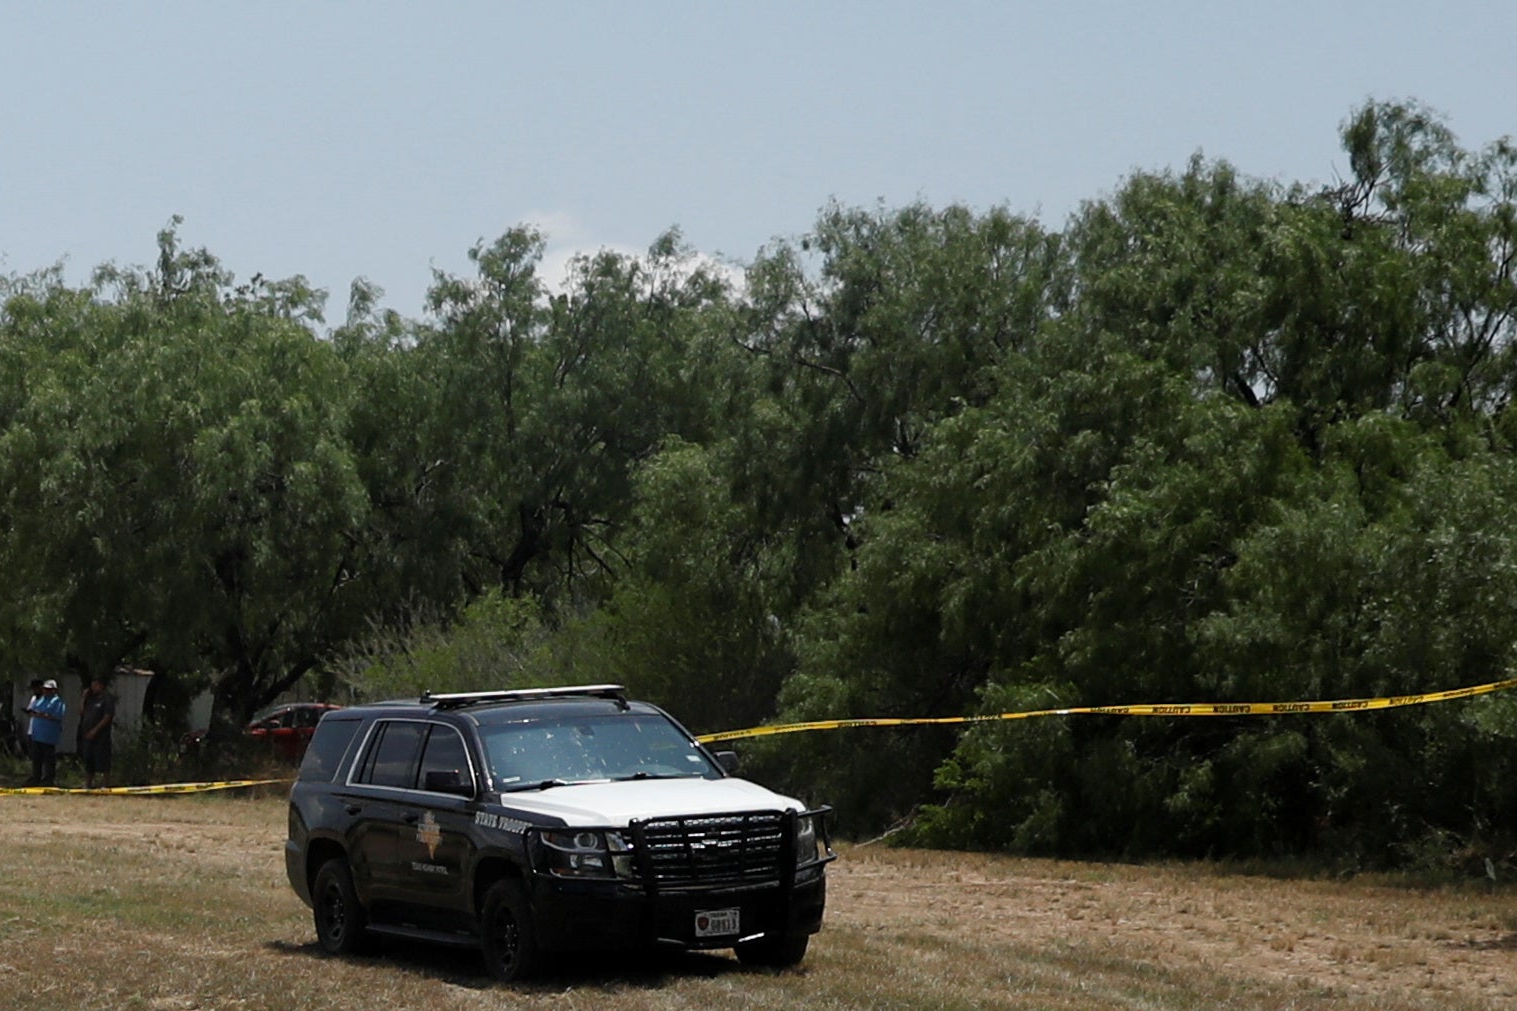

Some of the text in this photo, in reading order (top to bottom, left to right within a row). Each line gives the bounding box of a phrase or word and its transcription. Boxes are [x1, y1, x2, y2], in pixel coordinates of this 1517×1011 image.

[1212, 705, 1251, 713] CAUTION
[1272, 703, 1310, 712] CAUTION
[475, 811, 498, 828] STATE
